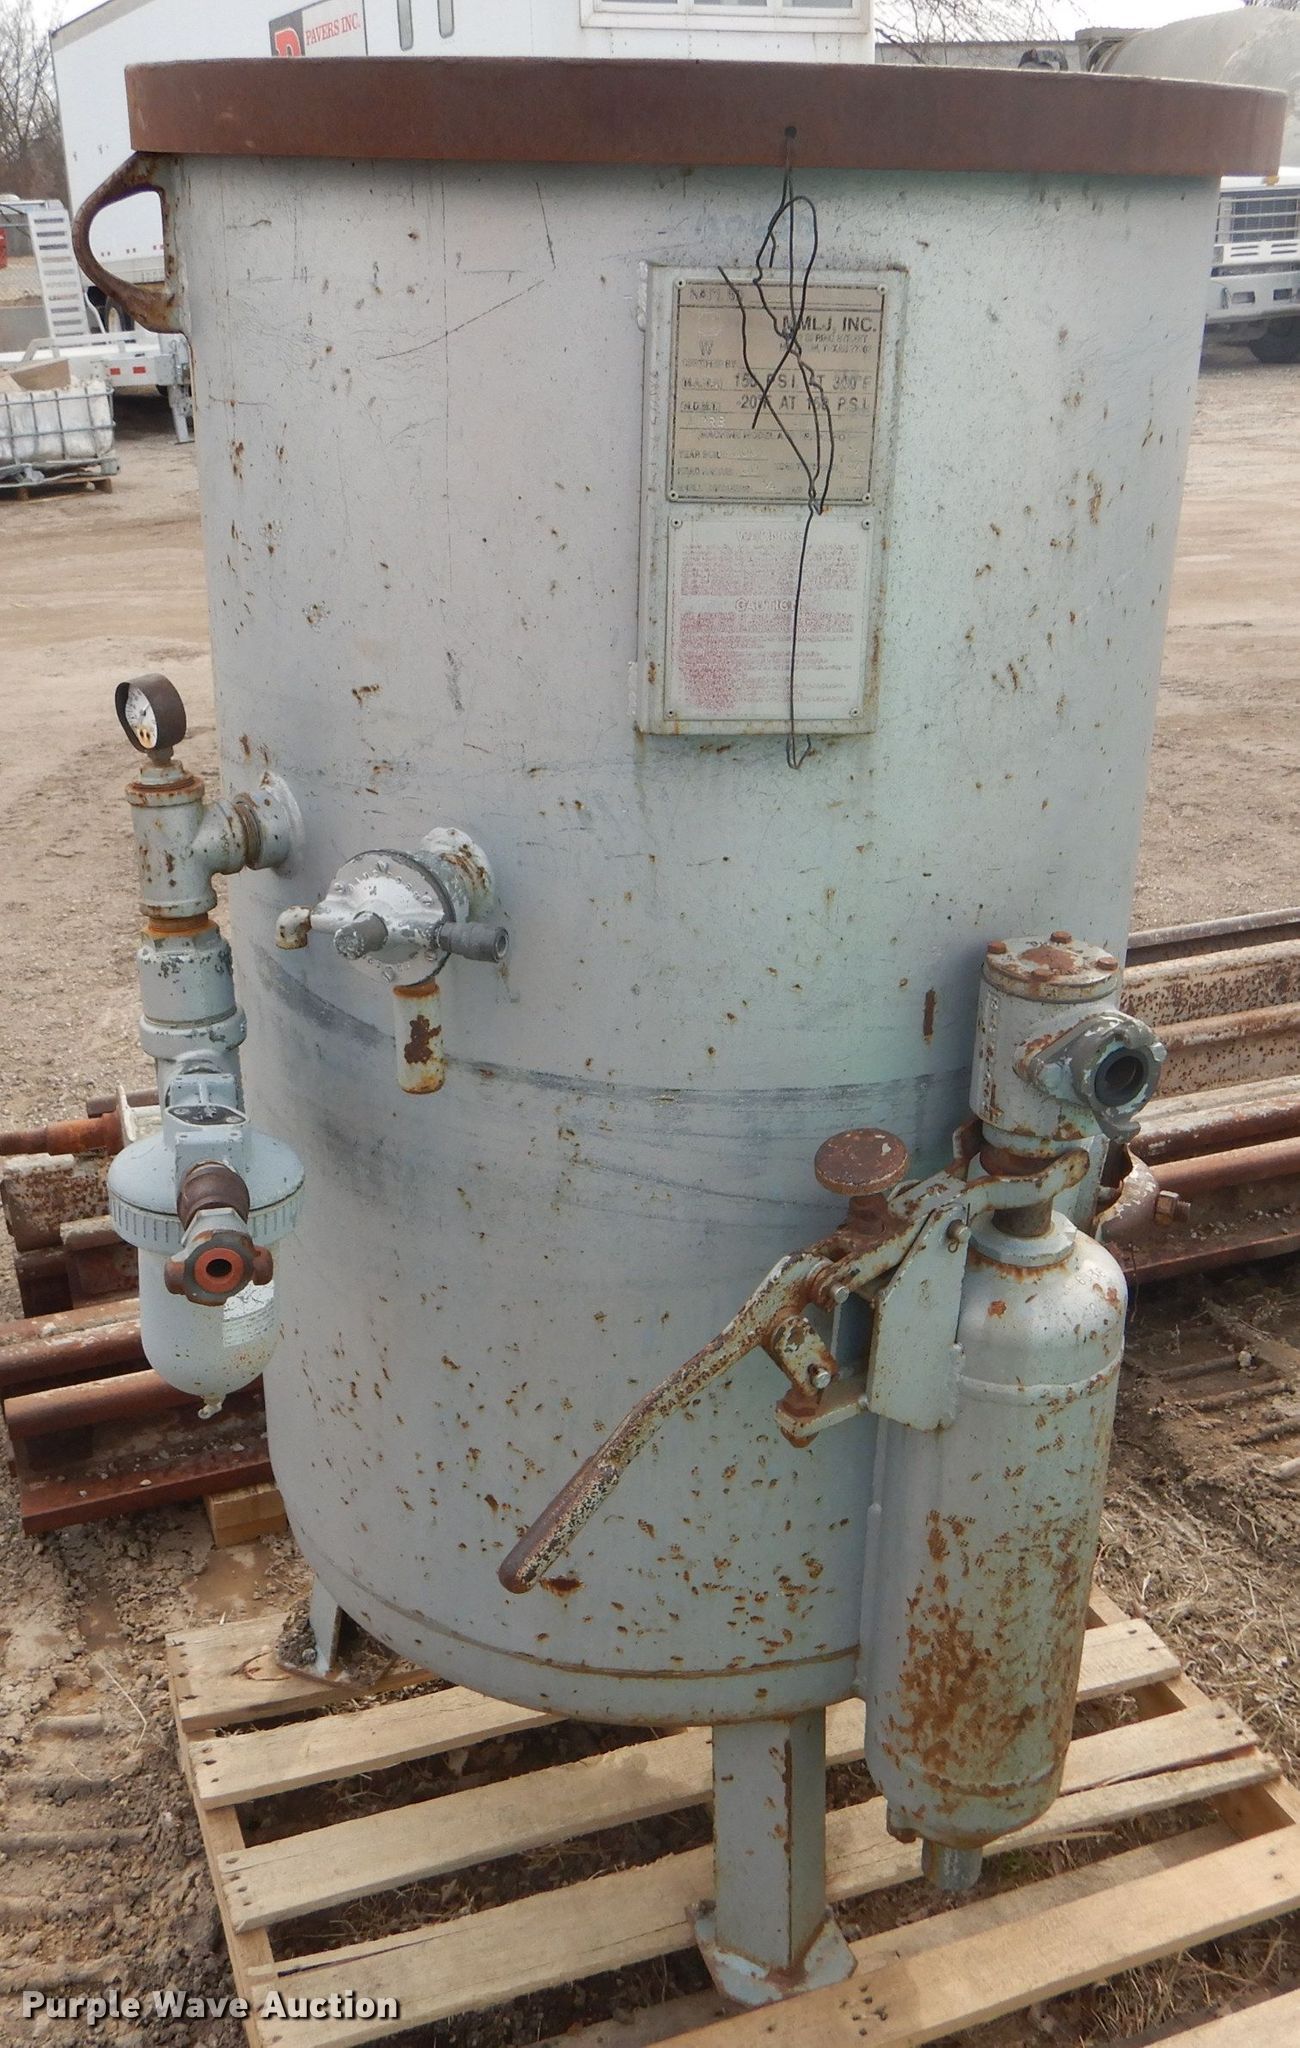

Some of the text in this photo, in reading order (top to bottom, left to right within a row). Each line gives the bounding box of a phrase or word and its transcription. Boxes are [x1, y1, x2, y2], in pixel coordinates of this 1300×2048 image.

[305, 20, 340, 46] PAVERS
[842, 316, 877, 332] INC.
[779, 395, 796, 410] AT
